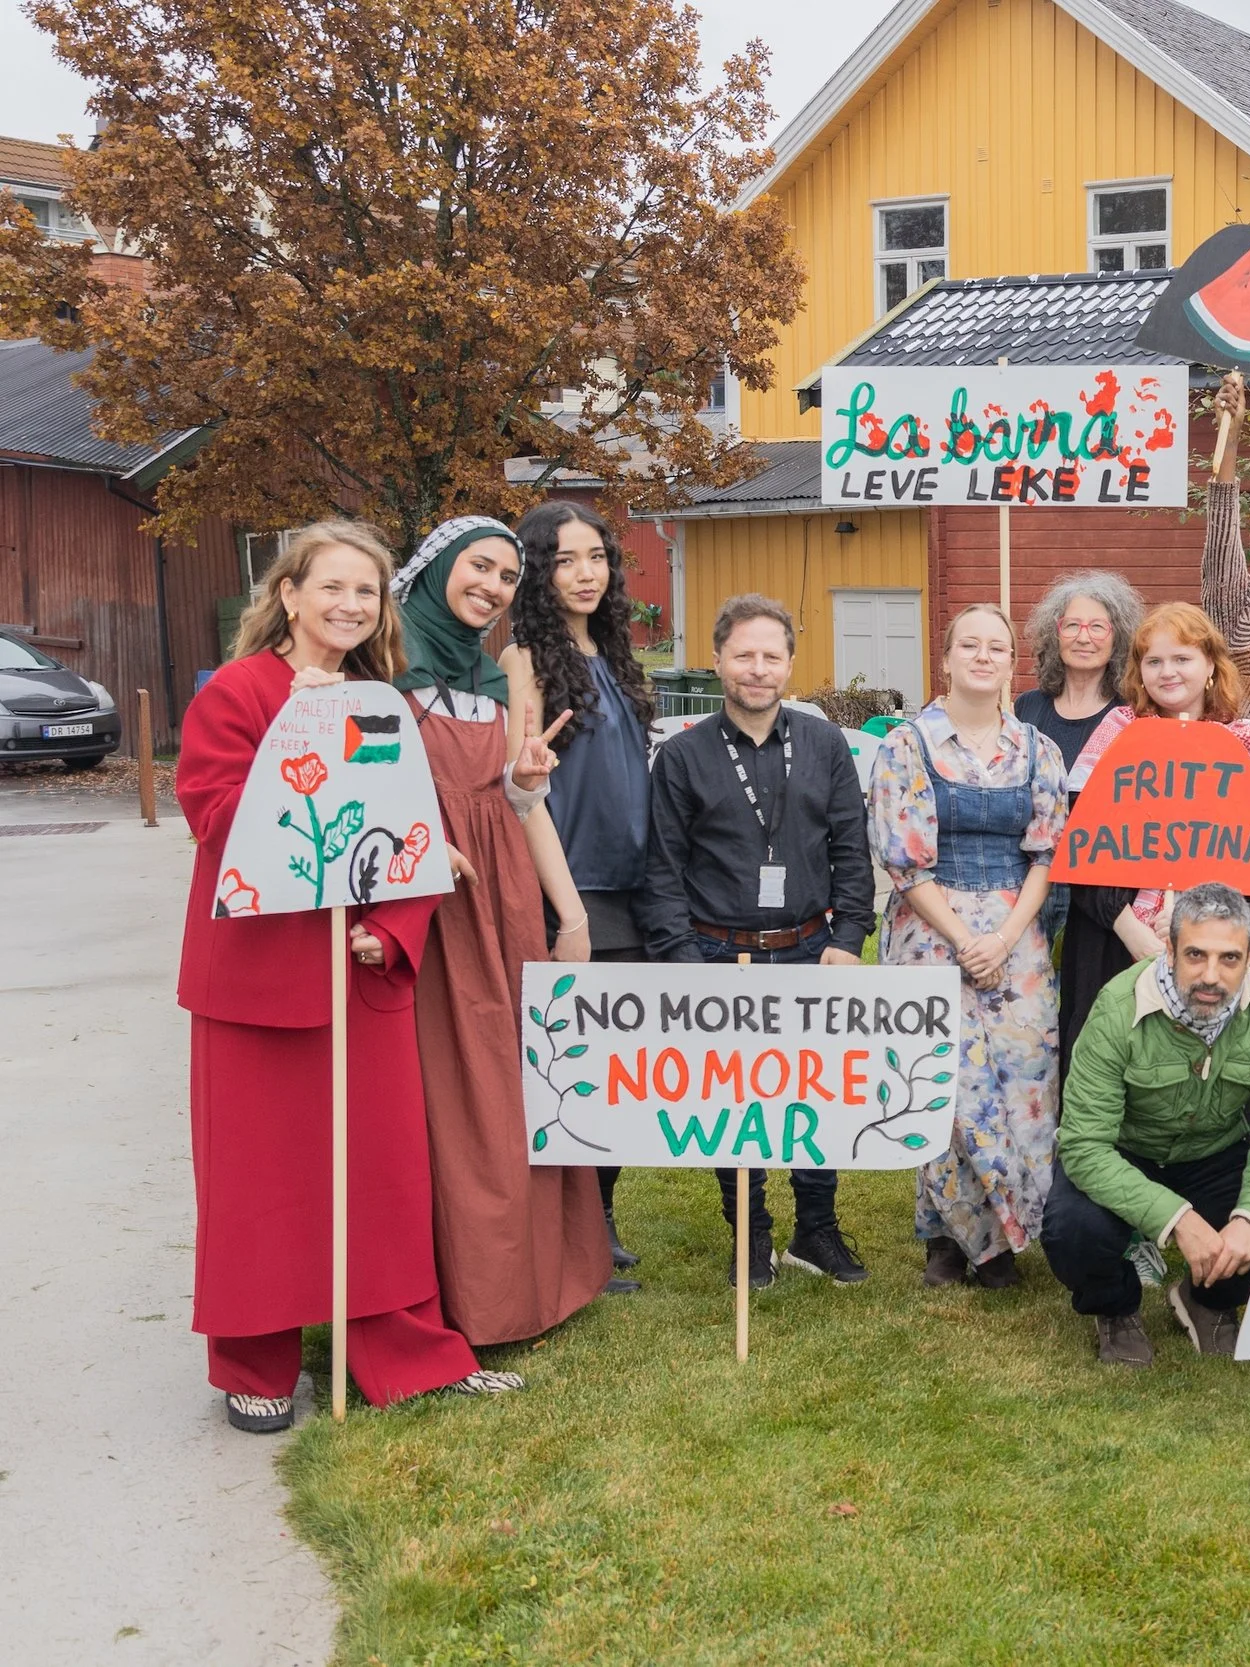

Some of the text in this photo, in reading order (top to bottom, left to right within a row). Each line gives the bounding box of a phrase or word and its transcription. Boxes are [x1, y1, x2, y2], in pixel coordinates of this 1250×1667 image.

[825, 382, 1122, 469] La barna
[841, 466, 1150, 503] LEVE LEKE LE
[279, 721, 335, 734] WILL BE
[296, 698, 361, 718] PALESTINA
[51, 725, 90, 736] DR 14754
[1113, 760, 1244, 803] FRITT
[574, 992, 951, 1038] NO MORE TERROR
[607, 1046, 869, 1105] NO MORE
[657, 1101, 826, 1166] WAR
